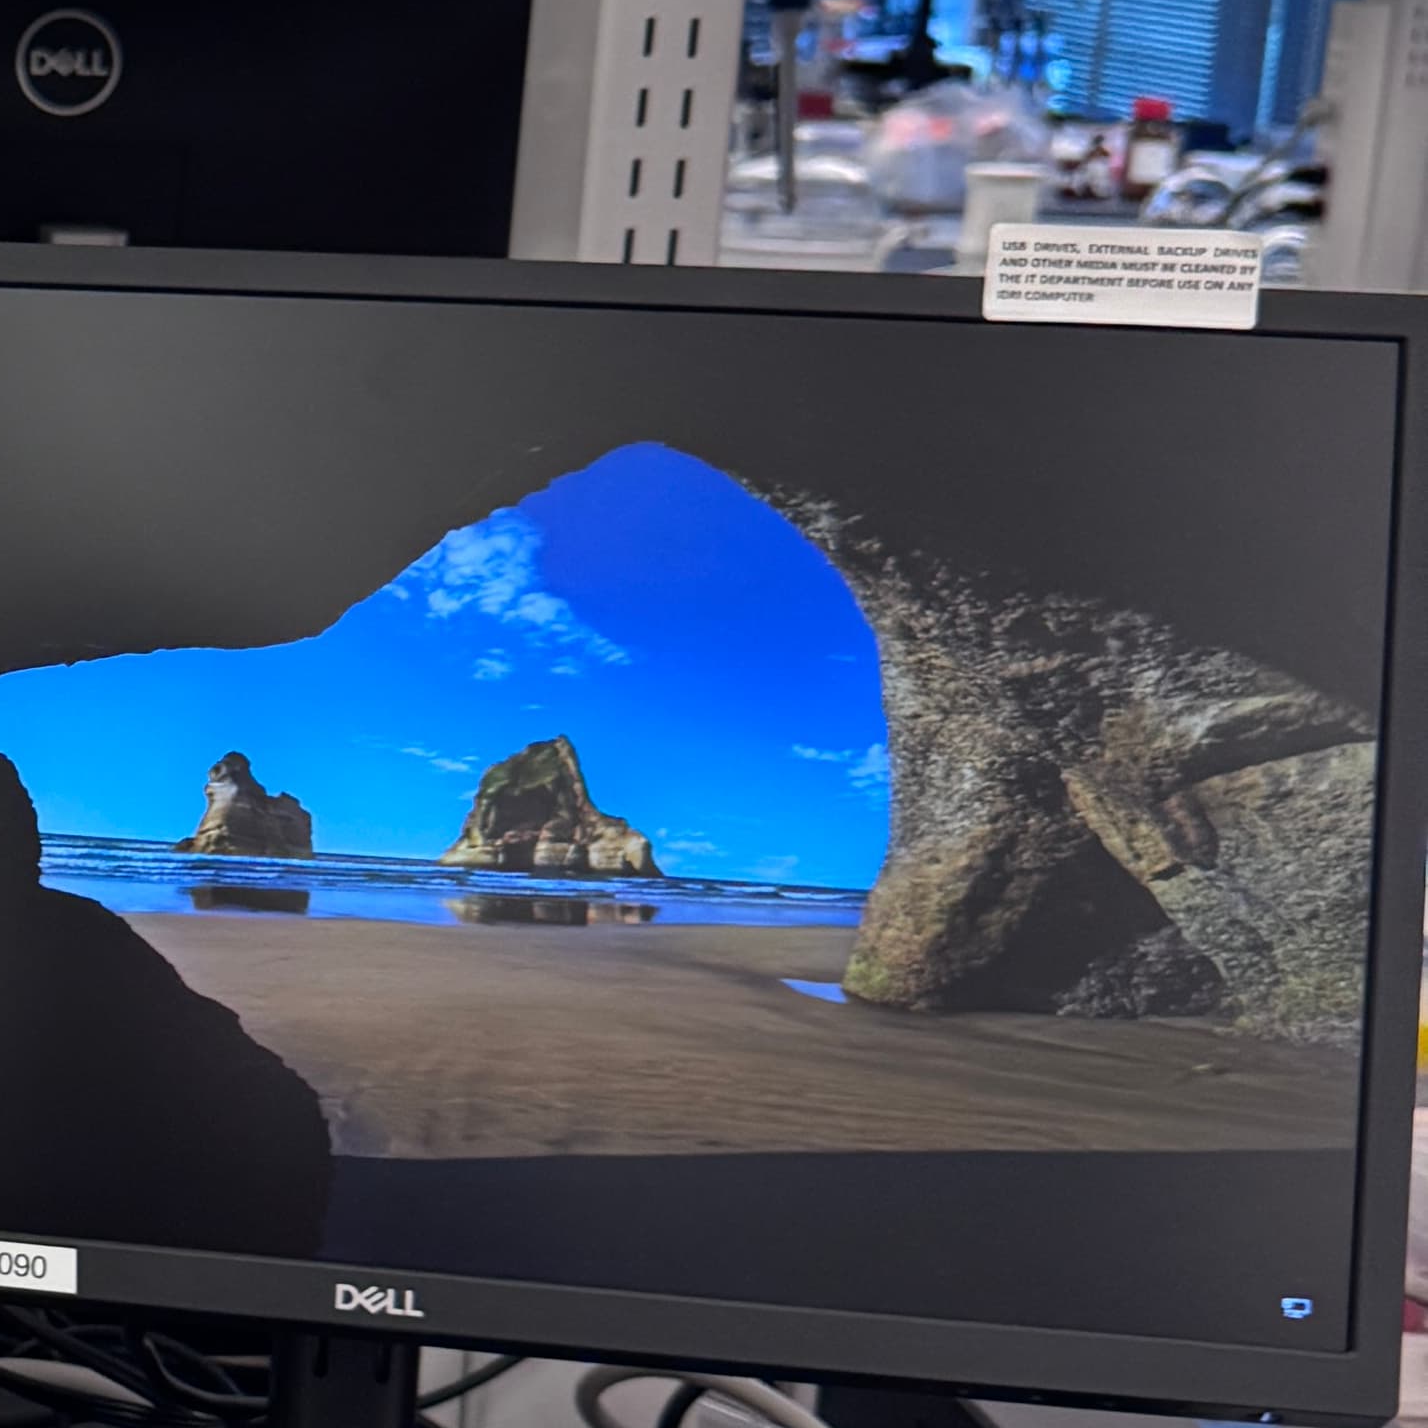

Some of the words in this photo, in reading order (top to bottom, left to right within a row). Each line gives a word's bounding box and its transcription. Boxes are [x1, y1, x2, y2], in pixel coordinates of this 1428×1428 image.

[29, 48, 110, 77] DELL
[1002, 241, 1026, 252] USB
[1088, 243, 1149, 257] EXTERNAL
[1157, 246, 1208, 258] BACKUP
[1214, 247, 1258, 260] DRIVES
[999, 258, 1027, 269] AND
[1031, 258, 1073, 270] OTHER
[1076, 260, 1117, 271] MEDIA
[1121, 261, 1156, 272] MUST
[1161, 262, 1176, 273] BE
[1180, 263, 1236, 275] CLEANED
[998, 273, 1021, 284] THE
[1023, 274, 1037, 285] IT
[1040, 274, 1123, 288] DEPARTMENT
[1127, 277, 1173, 289] BEFORE
[1177, 279, 1200, 291] USE
[1203, 280, 1223, 291] ON
[1226, 281, 1254, 292] ANY
[1024, 291, 1095, 303] COMPUTER
[334, 1282, 425, 1318] DELL
